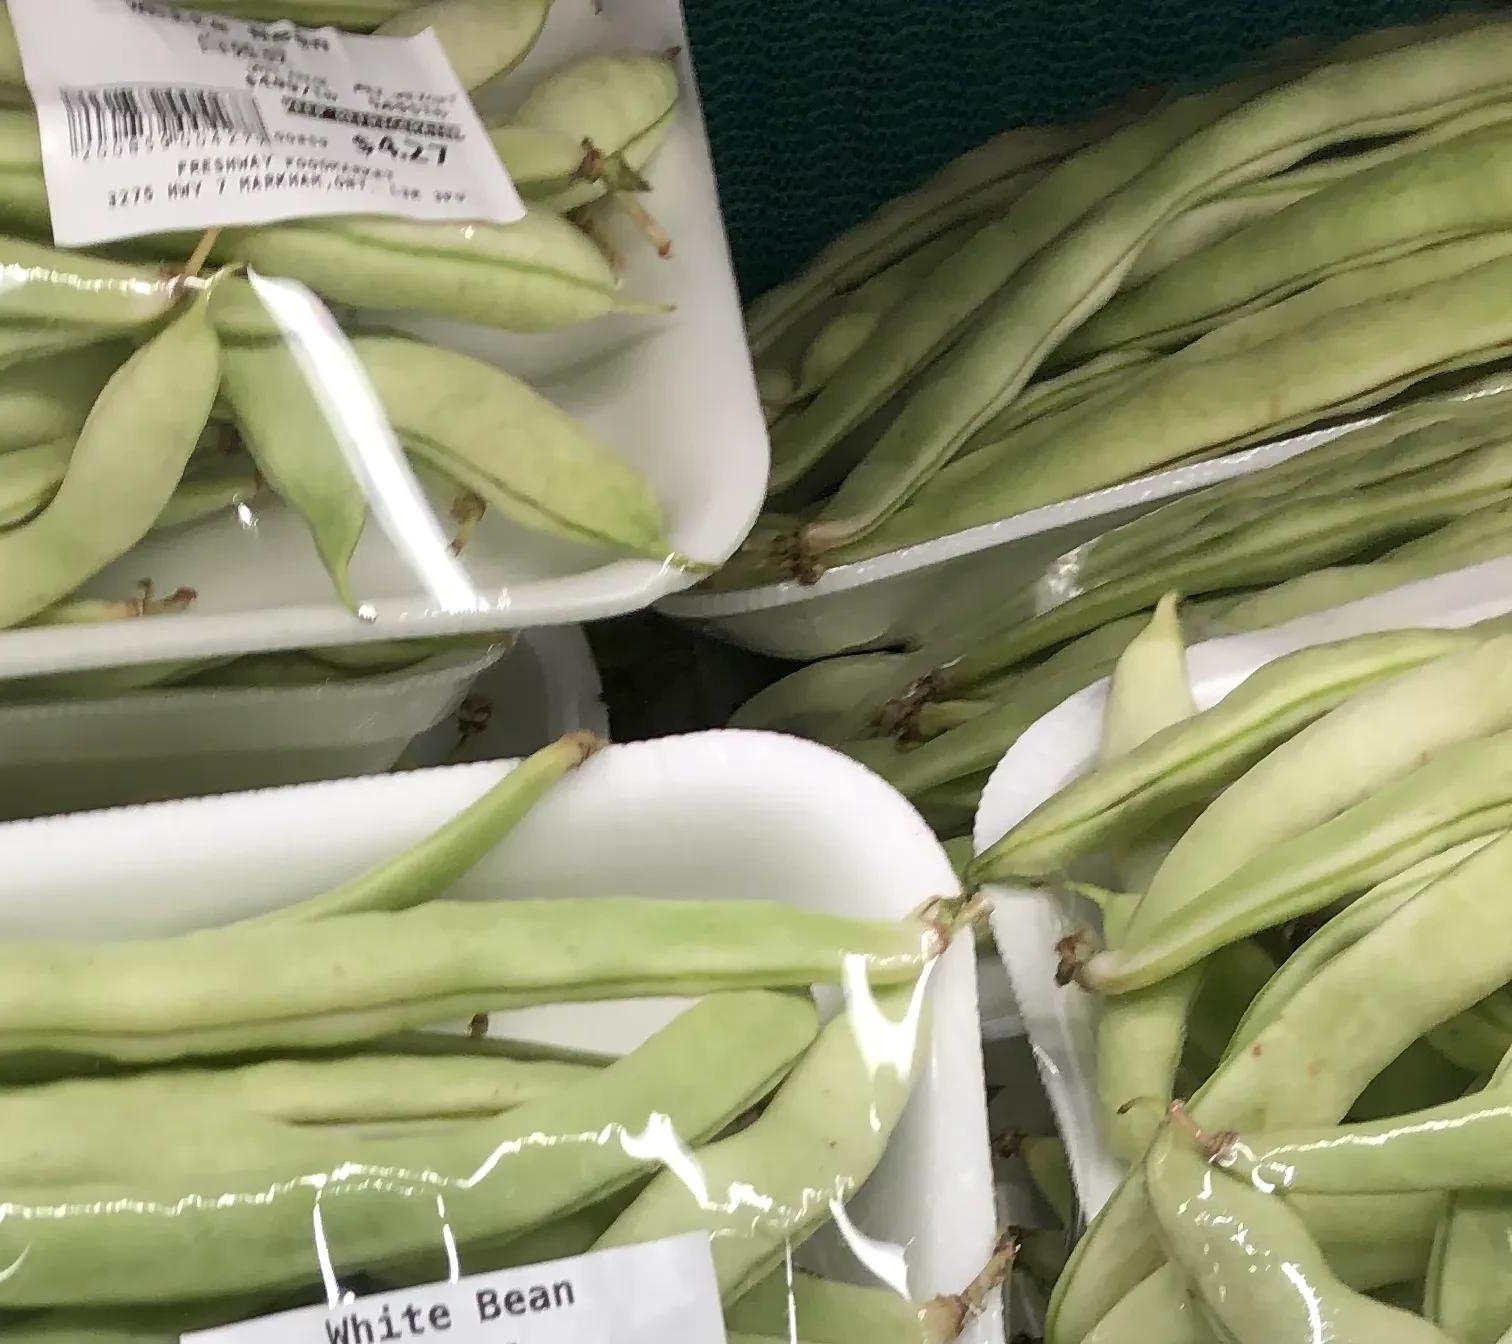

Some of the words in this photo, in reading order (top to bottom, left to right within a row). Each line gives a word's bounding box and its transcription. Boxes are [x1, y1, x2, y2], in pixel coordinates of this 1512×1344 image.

[177, 153, 273, 177] FRESHWAY
[351, 133, 449, 167] $4.27
[475, 1278, 575, 1323] Bean
